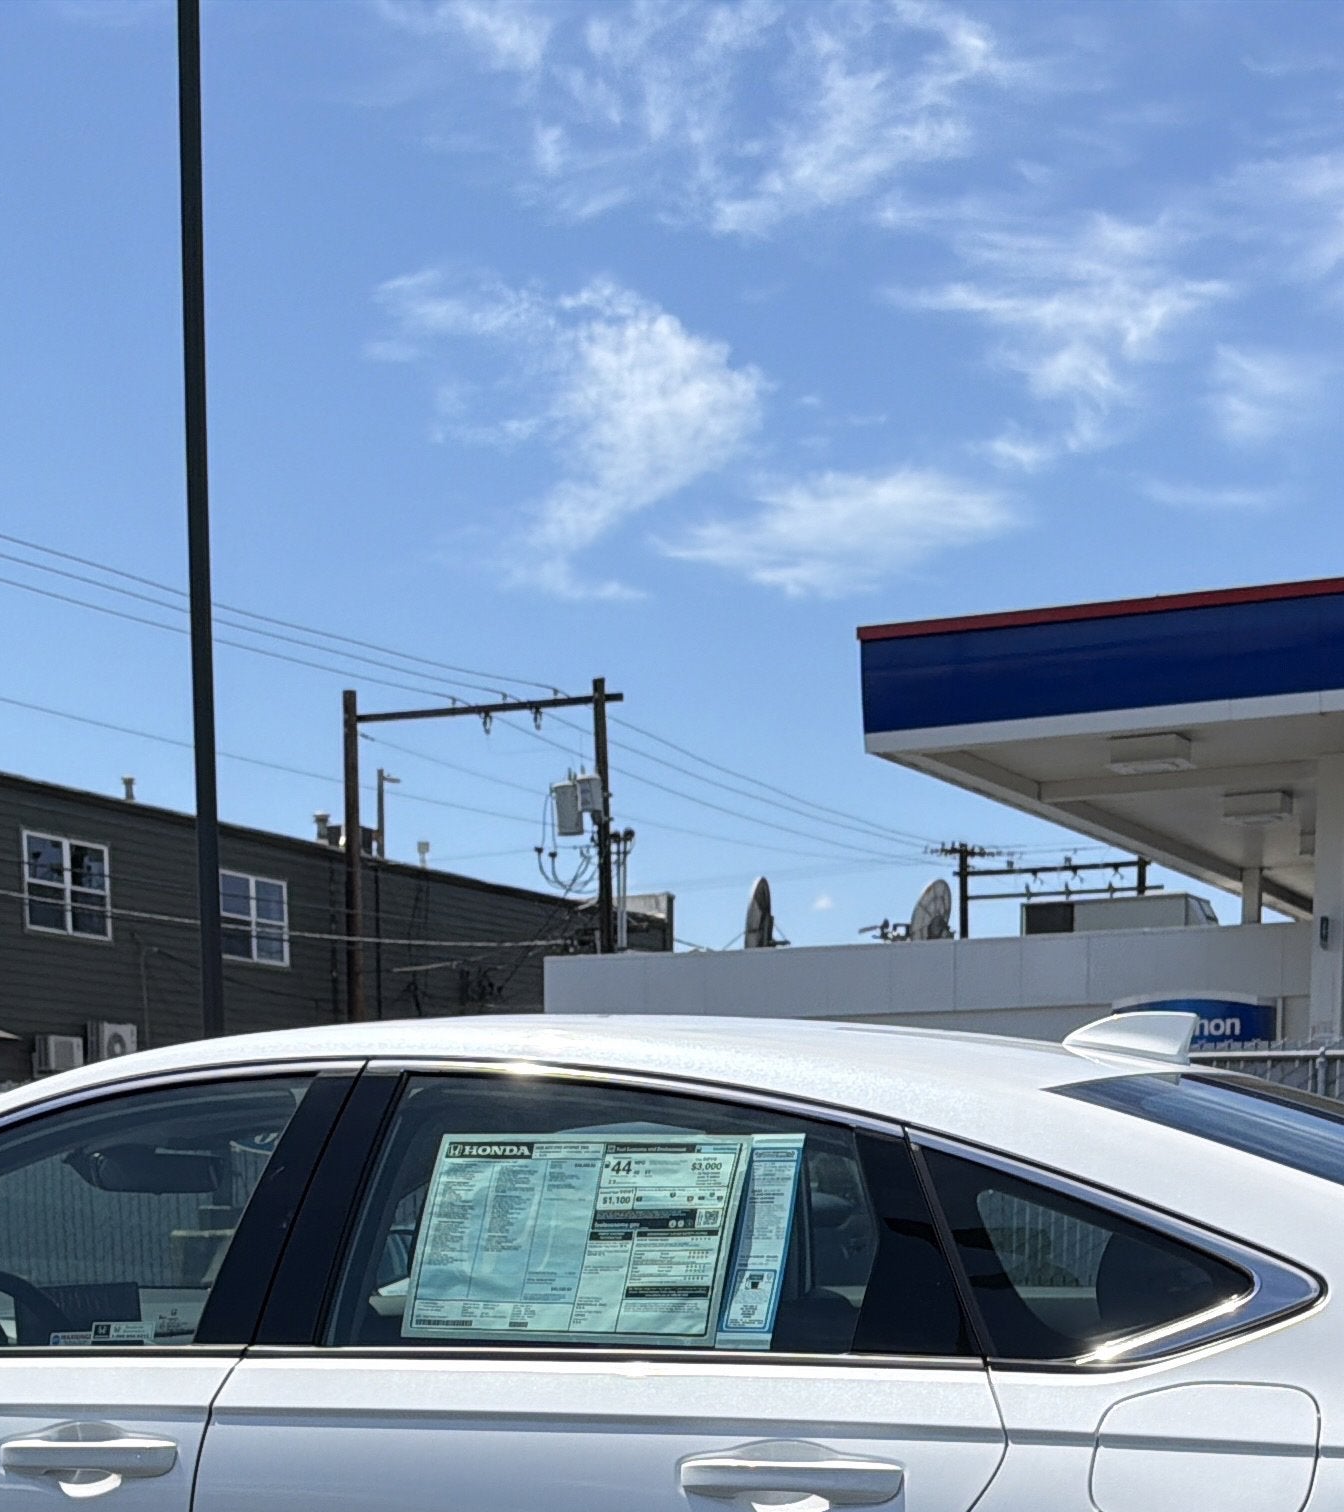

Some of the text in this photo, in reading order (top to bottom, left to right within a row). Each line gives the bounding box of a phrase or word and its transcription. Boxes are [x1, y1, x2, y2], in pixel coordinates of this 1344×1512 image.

[462, 1144, 532, 1157] HONDA
[610, 1160, 633, 1175] 44
[690, 1161, 723, 1172] $3,000
